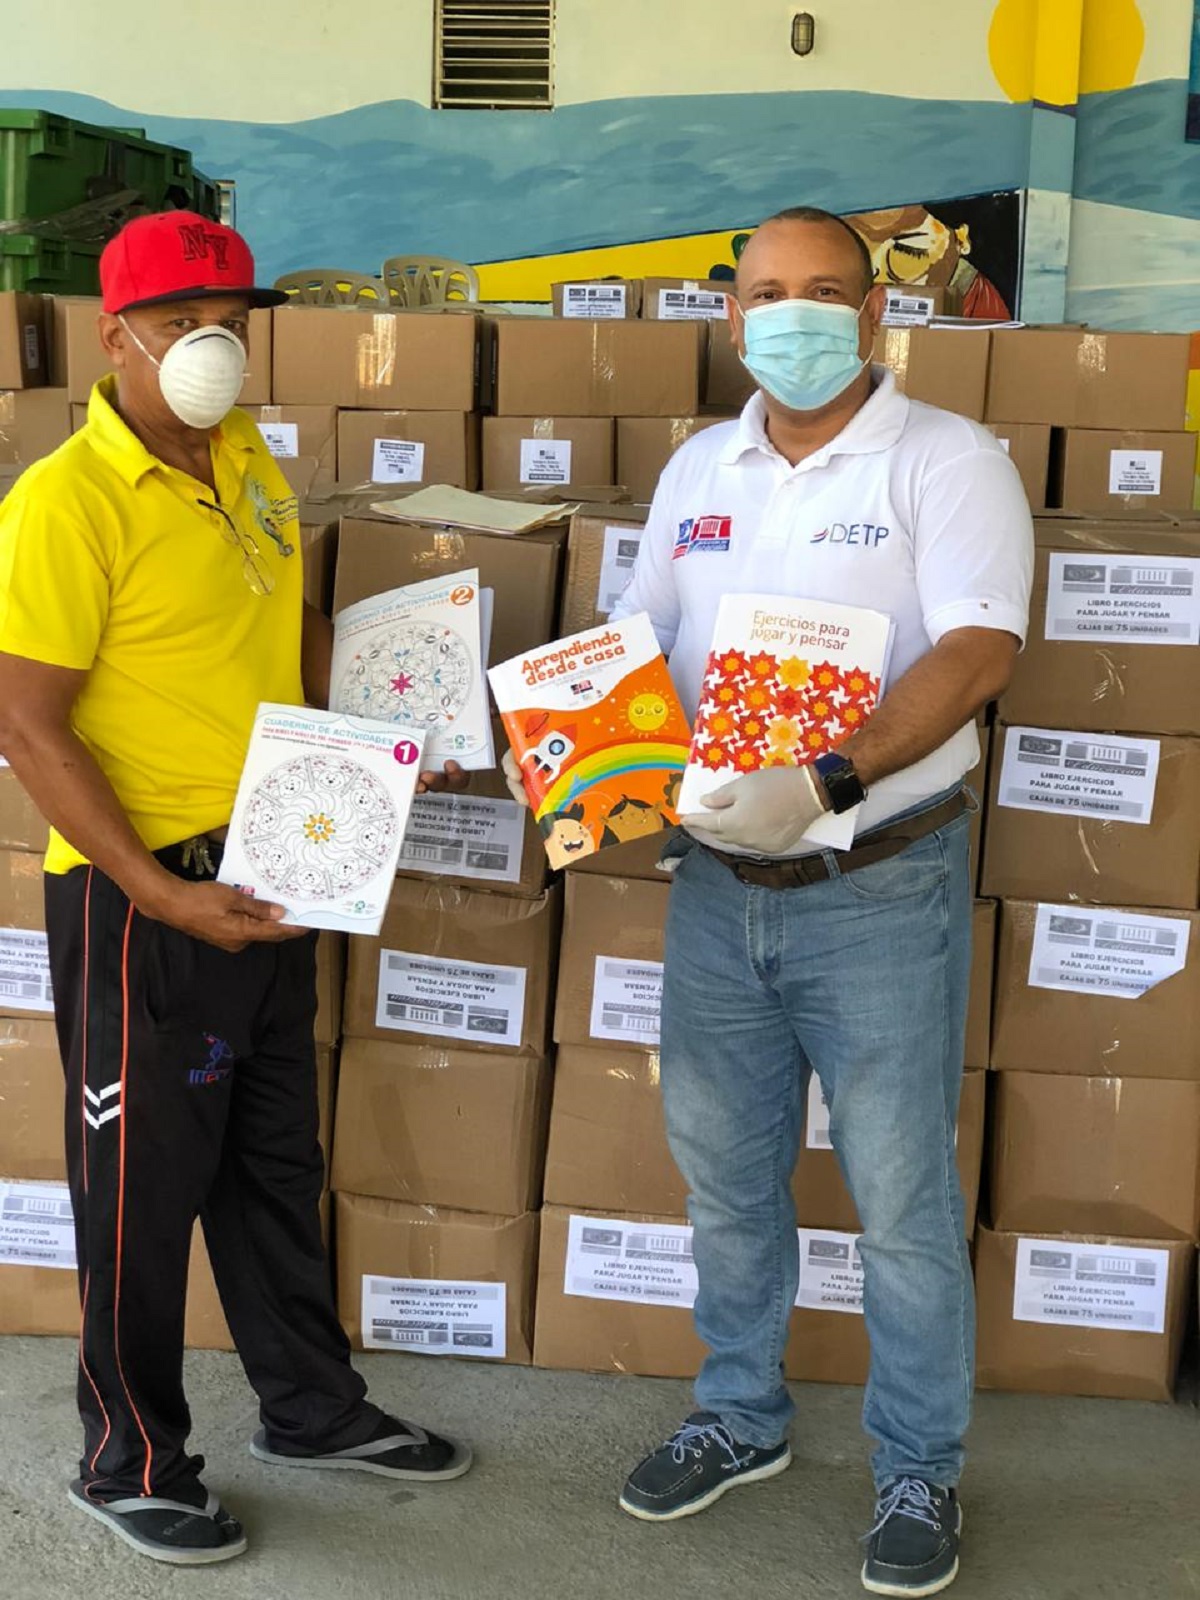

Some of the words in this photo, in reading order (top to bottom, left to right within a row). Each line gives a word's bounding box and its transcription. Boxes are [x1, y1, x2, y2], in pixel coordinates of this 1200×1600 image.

[178, 223, 229, 270] NY
[829, 523, 889, 547] DETP
[454, 588, 469, 604] 2
[1114, 600, 1162, 609] EJERCICIOS
[1077, 609, 1099, 617] PARA
[1138, 611, 1171, 619] PENSAR
[753, 610, 816, 631] Ejercicios
[819, 623, 850, 638] para
[1115, 623, 1129, 632] 75
[1129, 625, 1169, 633] UNIDADES
[750, 628, 787, 642] jugar
[788, 631, 798, 645] y
[799, 633, 848, 651] pensar
[521, 631, 622, 674] Aprendiendo
[525, 658, 577, 686] desde
[583, 645, 626, 666] casa
[263, 718, 316, 731] CUADERNO
[318, 724, 330, 734] DE
[333, 728, 394, 746] ACTIVIDADES
[399, 743, 411, 763] 1
[1040, 772, 1065, 781] LIBRO
[1067, 774, 1115, 786] EJERCICIOS
[1029, 779, 1051, 789] PARA
[1053, 783, 1080, 792] JUGAR
[1090, 787, 1123, 796] PENSAR
[1029, 794, 1054, 804] CAJAS
[1067, 798, 1080, 806] 75
[1081, 802, 1120, 811] UNIDADES
[410, 812, 437, 820] PENSA
[1070, 952, 1095, 961] LIBRO
[1097, 954, 1144, 966] EJERCICIOS
[409, 962, 446, 972] UNIDADES
[446, 968, 459, 976] 75
[1060, 960, 1081, 969] PARA
[1083, 963, 1110, 972] JUGAR
[1120, 967, 1153, 977] PENSAR
[407, 975, 438, 985] PENSAR
[471, 970, 495, 979] CAJAS
[1059, 974, 1085, 983] CAJAS
[1098, 977, 1110, 986] 75
[415, 985, 460, 997] EJERCICIOS
[446, 981, 473, 990] JUGAR
[474, 985, 496, 993] PARA
[463, 992, 486, 1000] LIBRO
[603, 1261, 627, 1270] LIBRO
[628, 1264, 675, 1275] EJERCICIOS
[594, 1269, 616, 1277] PARA
[616, 1272, 642, 1280] JUGAR
[651, 1275, 683, 1284] PENSAR
[391, 1285, 428, 1293] UNIDADES
[429, 1287, 441, 1296] 75
[453, 1288, 477, 1296] CAJAS
[594, 1282, 617, 1291] CAJAS
[619, 1285, 629, 1293] DE
[630, 1285, 642, 1294] 75
[643, 1288, 680, 1298] UNIDADES
[1053, 1284, 1077, 1292] LIBRO
[1079, 1287, 1126, 1296] EJERCICIOS
[429, 1301, 456, 1309] JUGAR
[1043, 1293, 1065, 1301] PARA
[1066, 1296, 1094, 1304] JUGAR
[1103, 1299, 1135, 1307] PENSAR
[399, 1308, 444, 1316] EJERCICIOS
[1043, 1307, 1067, 1316] CAJAS
[1081, 1309, 1093, 1318] 75
[1094, 1312, 1133, 1321] UNIDADES
